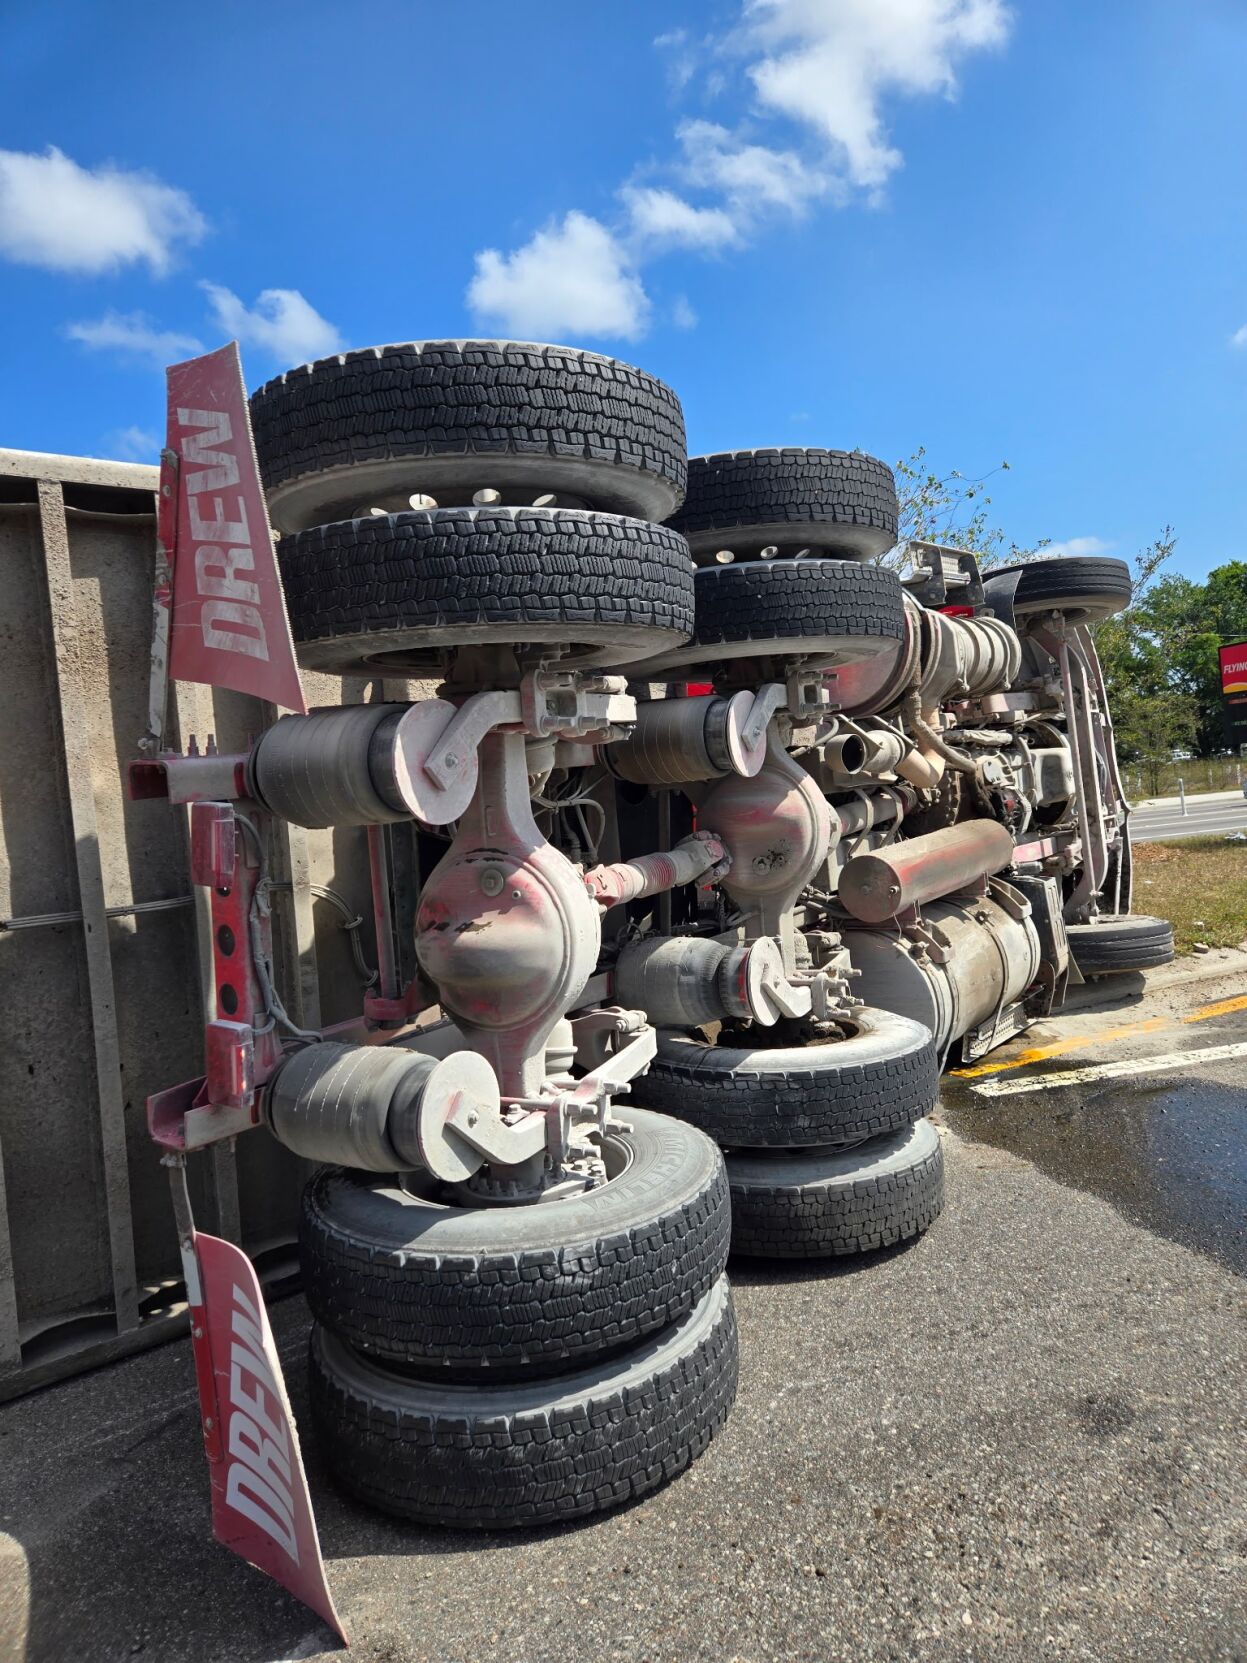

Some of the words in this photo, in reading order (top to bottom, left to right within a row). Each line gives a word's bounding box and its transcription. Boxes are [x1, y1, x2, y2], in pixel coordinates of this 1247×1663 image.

[178, 408, 269, 661] DREW
[593, 1137, 685, 1209] MICHELIN
[226, 1283, 299, 1567] DREW
